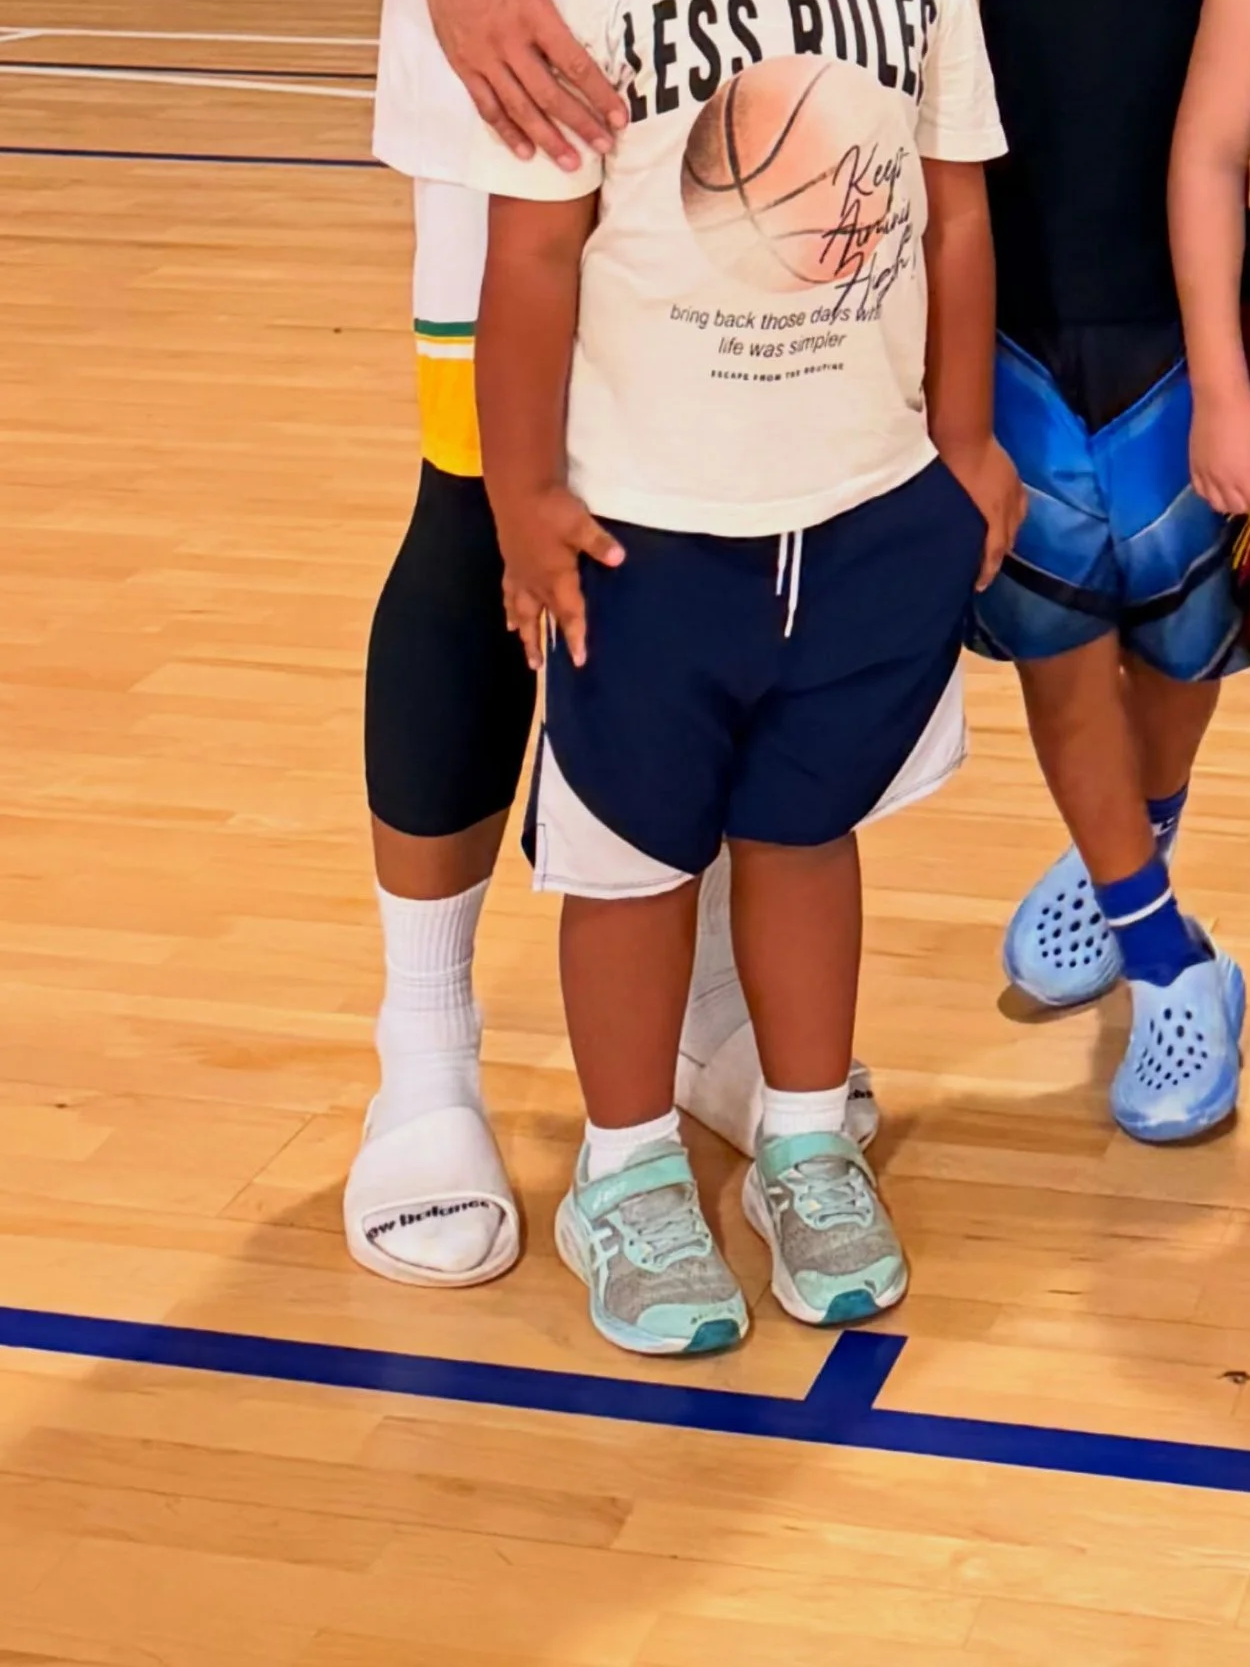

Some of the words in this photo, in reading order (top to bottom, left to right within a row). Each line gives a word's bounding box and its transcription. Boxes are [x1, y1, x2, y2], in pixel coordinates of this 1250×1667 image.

[670, 304, 709, 329] bring
[713, 309, 756, 329] back
[760, 311, 806, 330] those
[810, 306, 850, 326] days
[718, 337, 744, 356] life
[749, 342, 784, 358] was
[366, 1220, 395, 1239] ew
